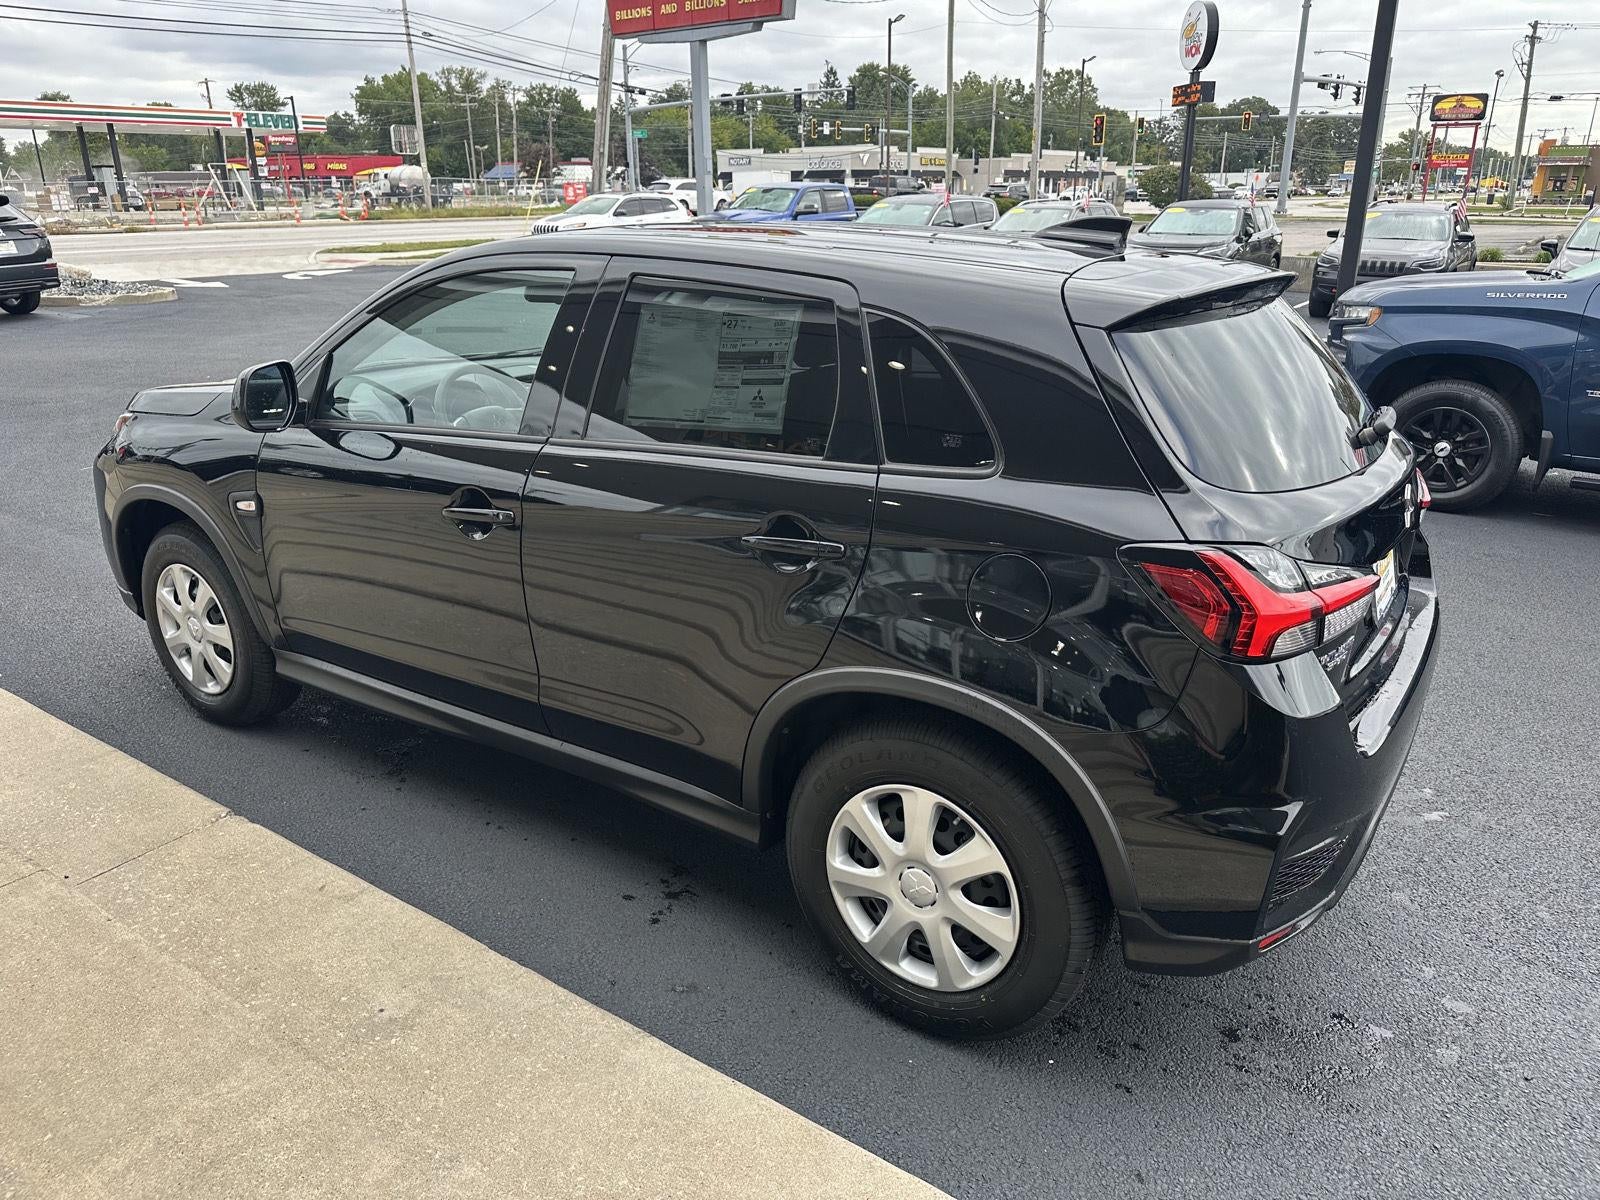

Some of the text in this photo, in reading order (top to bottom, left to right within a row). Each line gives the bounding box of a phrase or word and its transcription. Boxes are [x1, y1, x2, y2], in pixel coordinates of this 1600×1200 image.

[615, 0, 727, 21] BILLIONS AND BILLIONS
[1184, 43, 1201, 58] WOK
[327, 162, 348, 171] MIDAS
[729, 158, 750, 166] NOTARY
